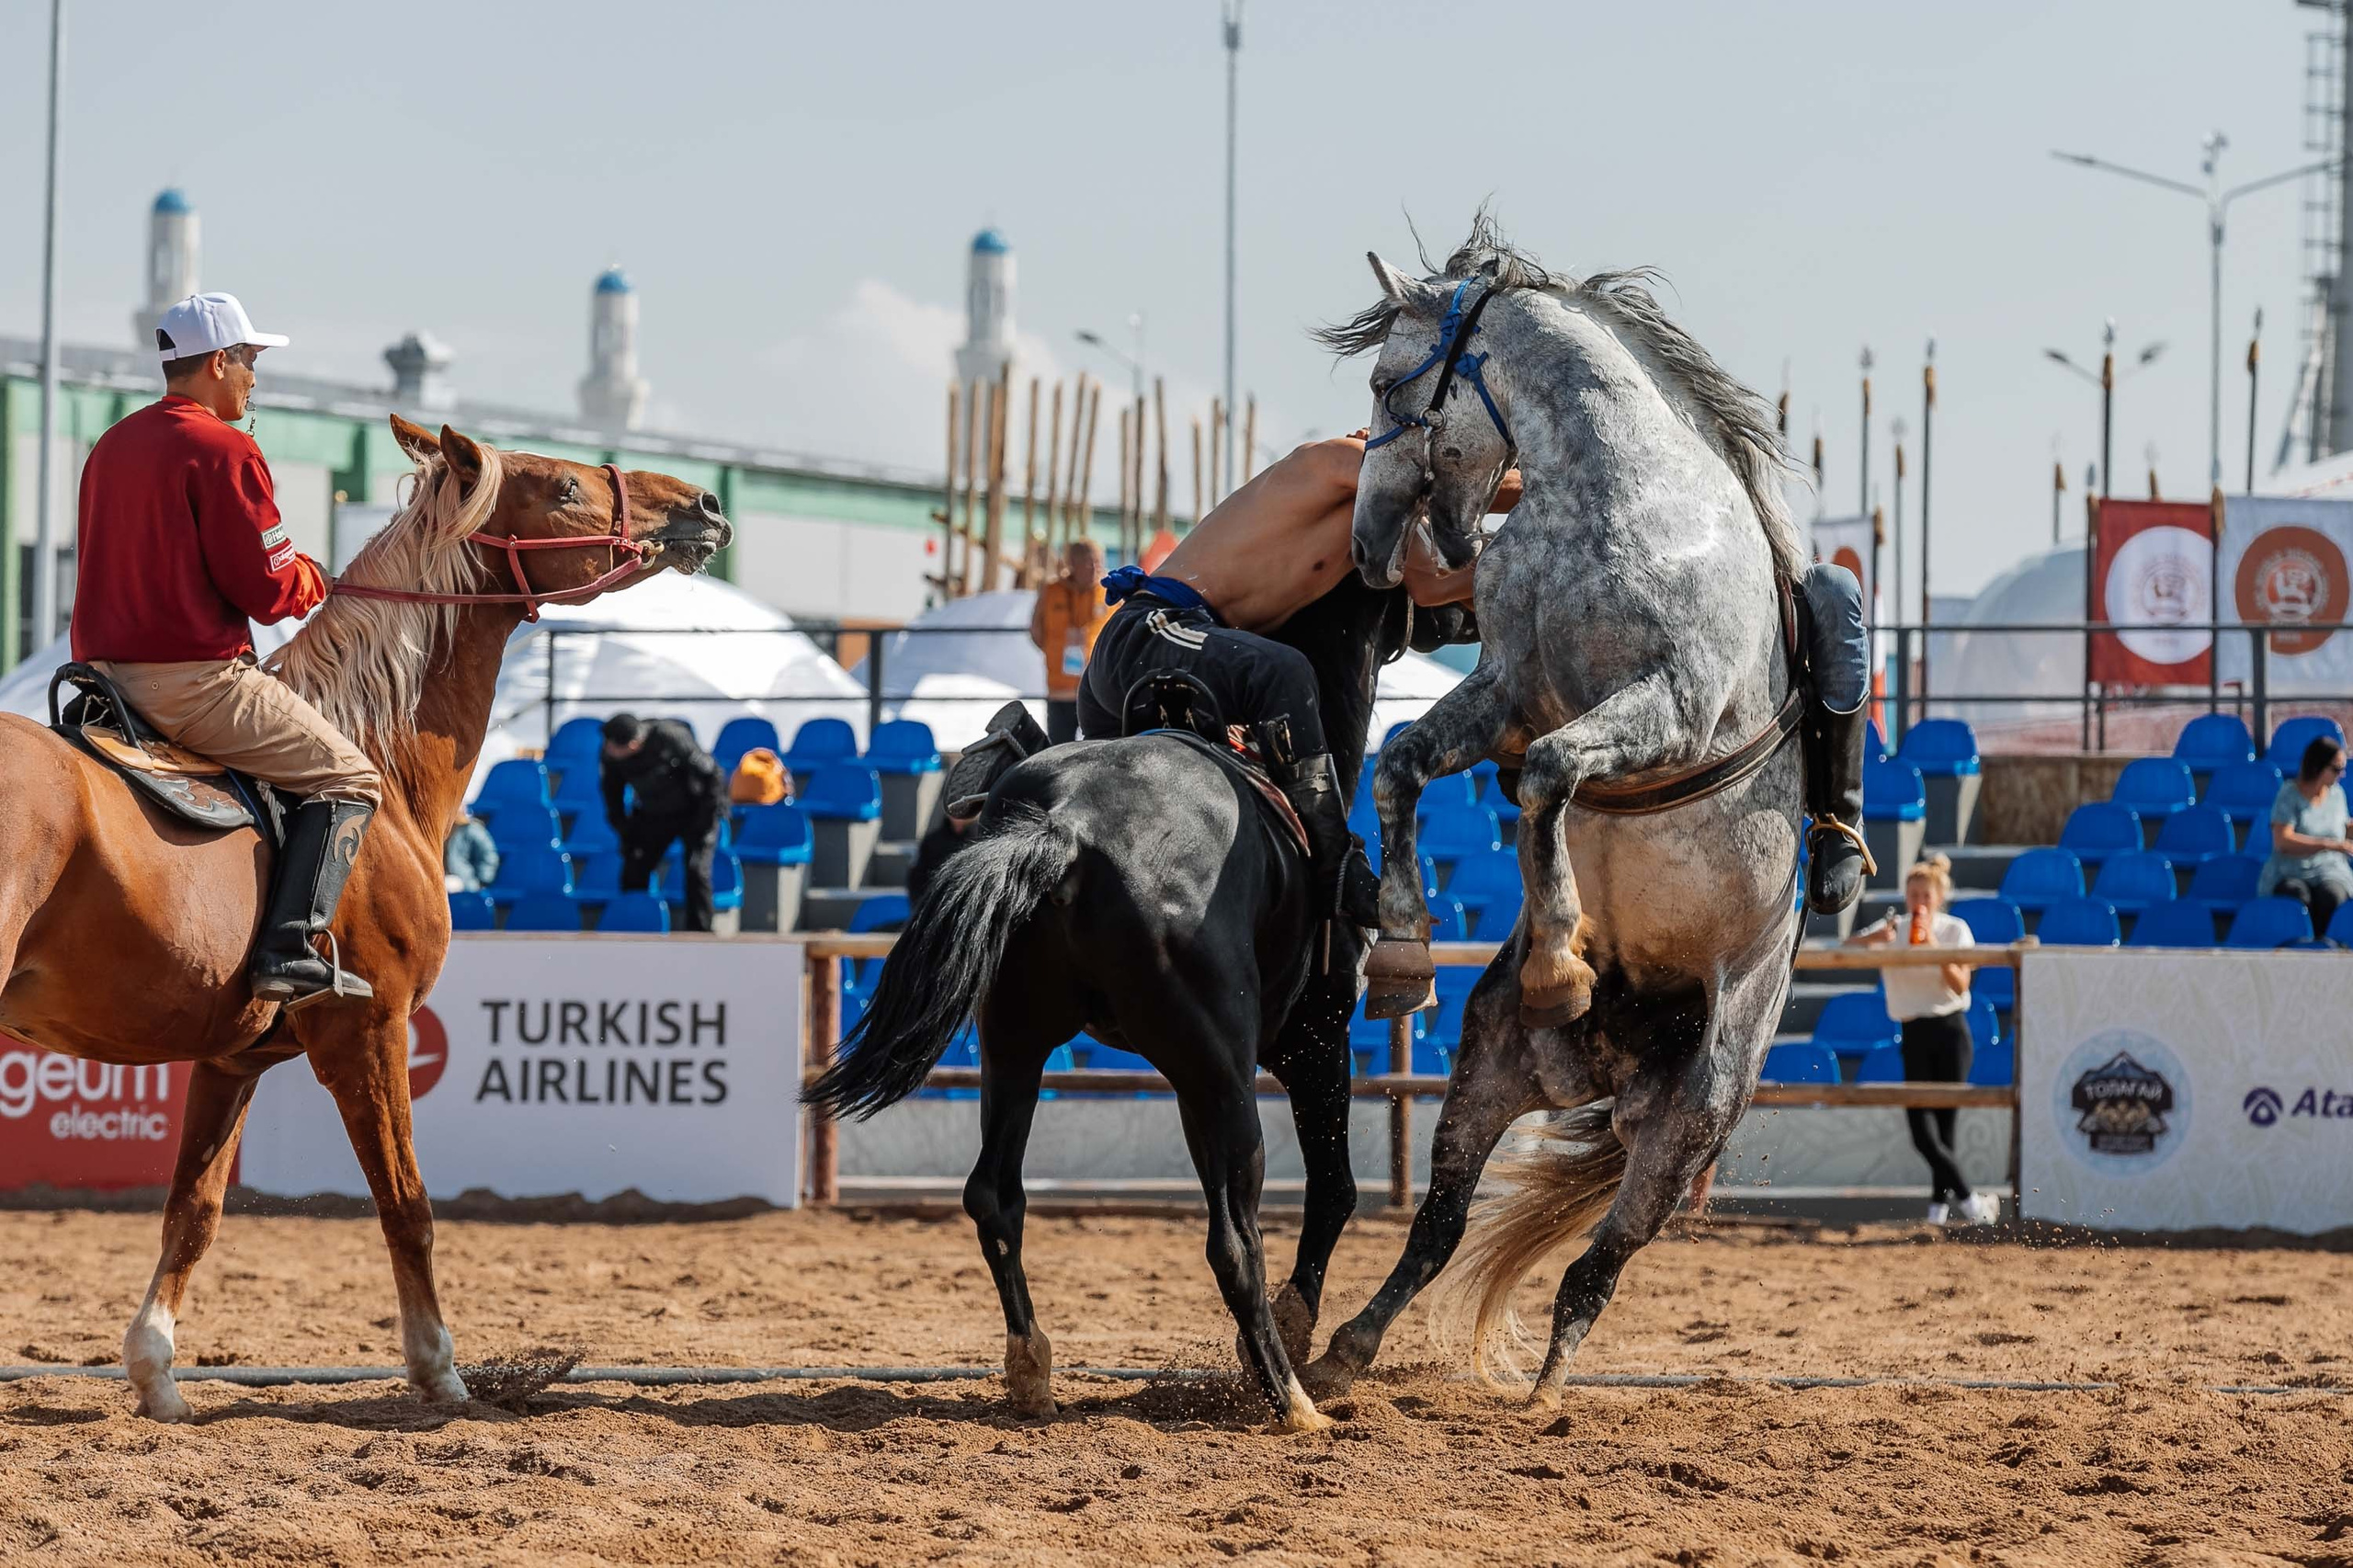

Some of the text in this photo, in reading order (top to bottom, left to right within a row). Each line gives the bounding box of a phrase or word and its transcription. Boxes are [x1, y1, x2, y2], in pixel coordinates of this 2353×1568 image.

[481, 1000, 726, 1046] TURKISH
[475, 1060, 728, 1104] AIRLINES
[50, 1102, 168, 1141] electric
